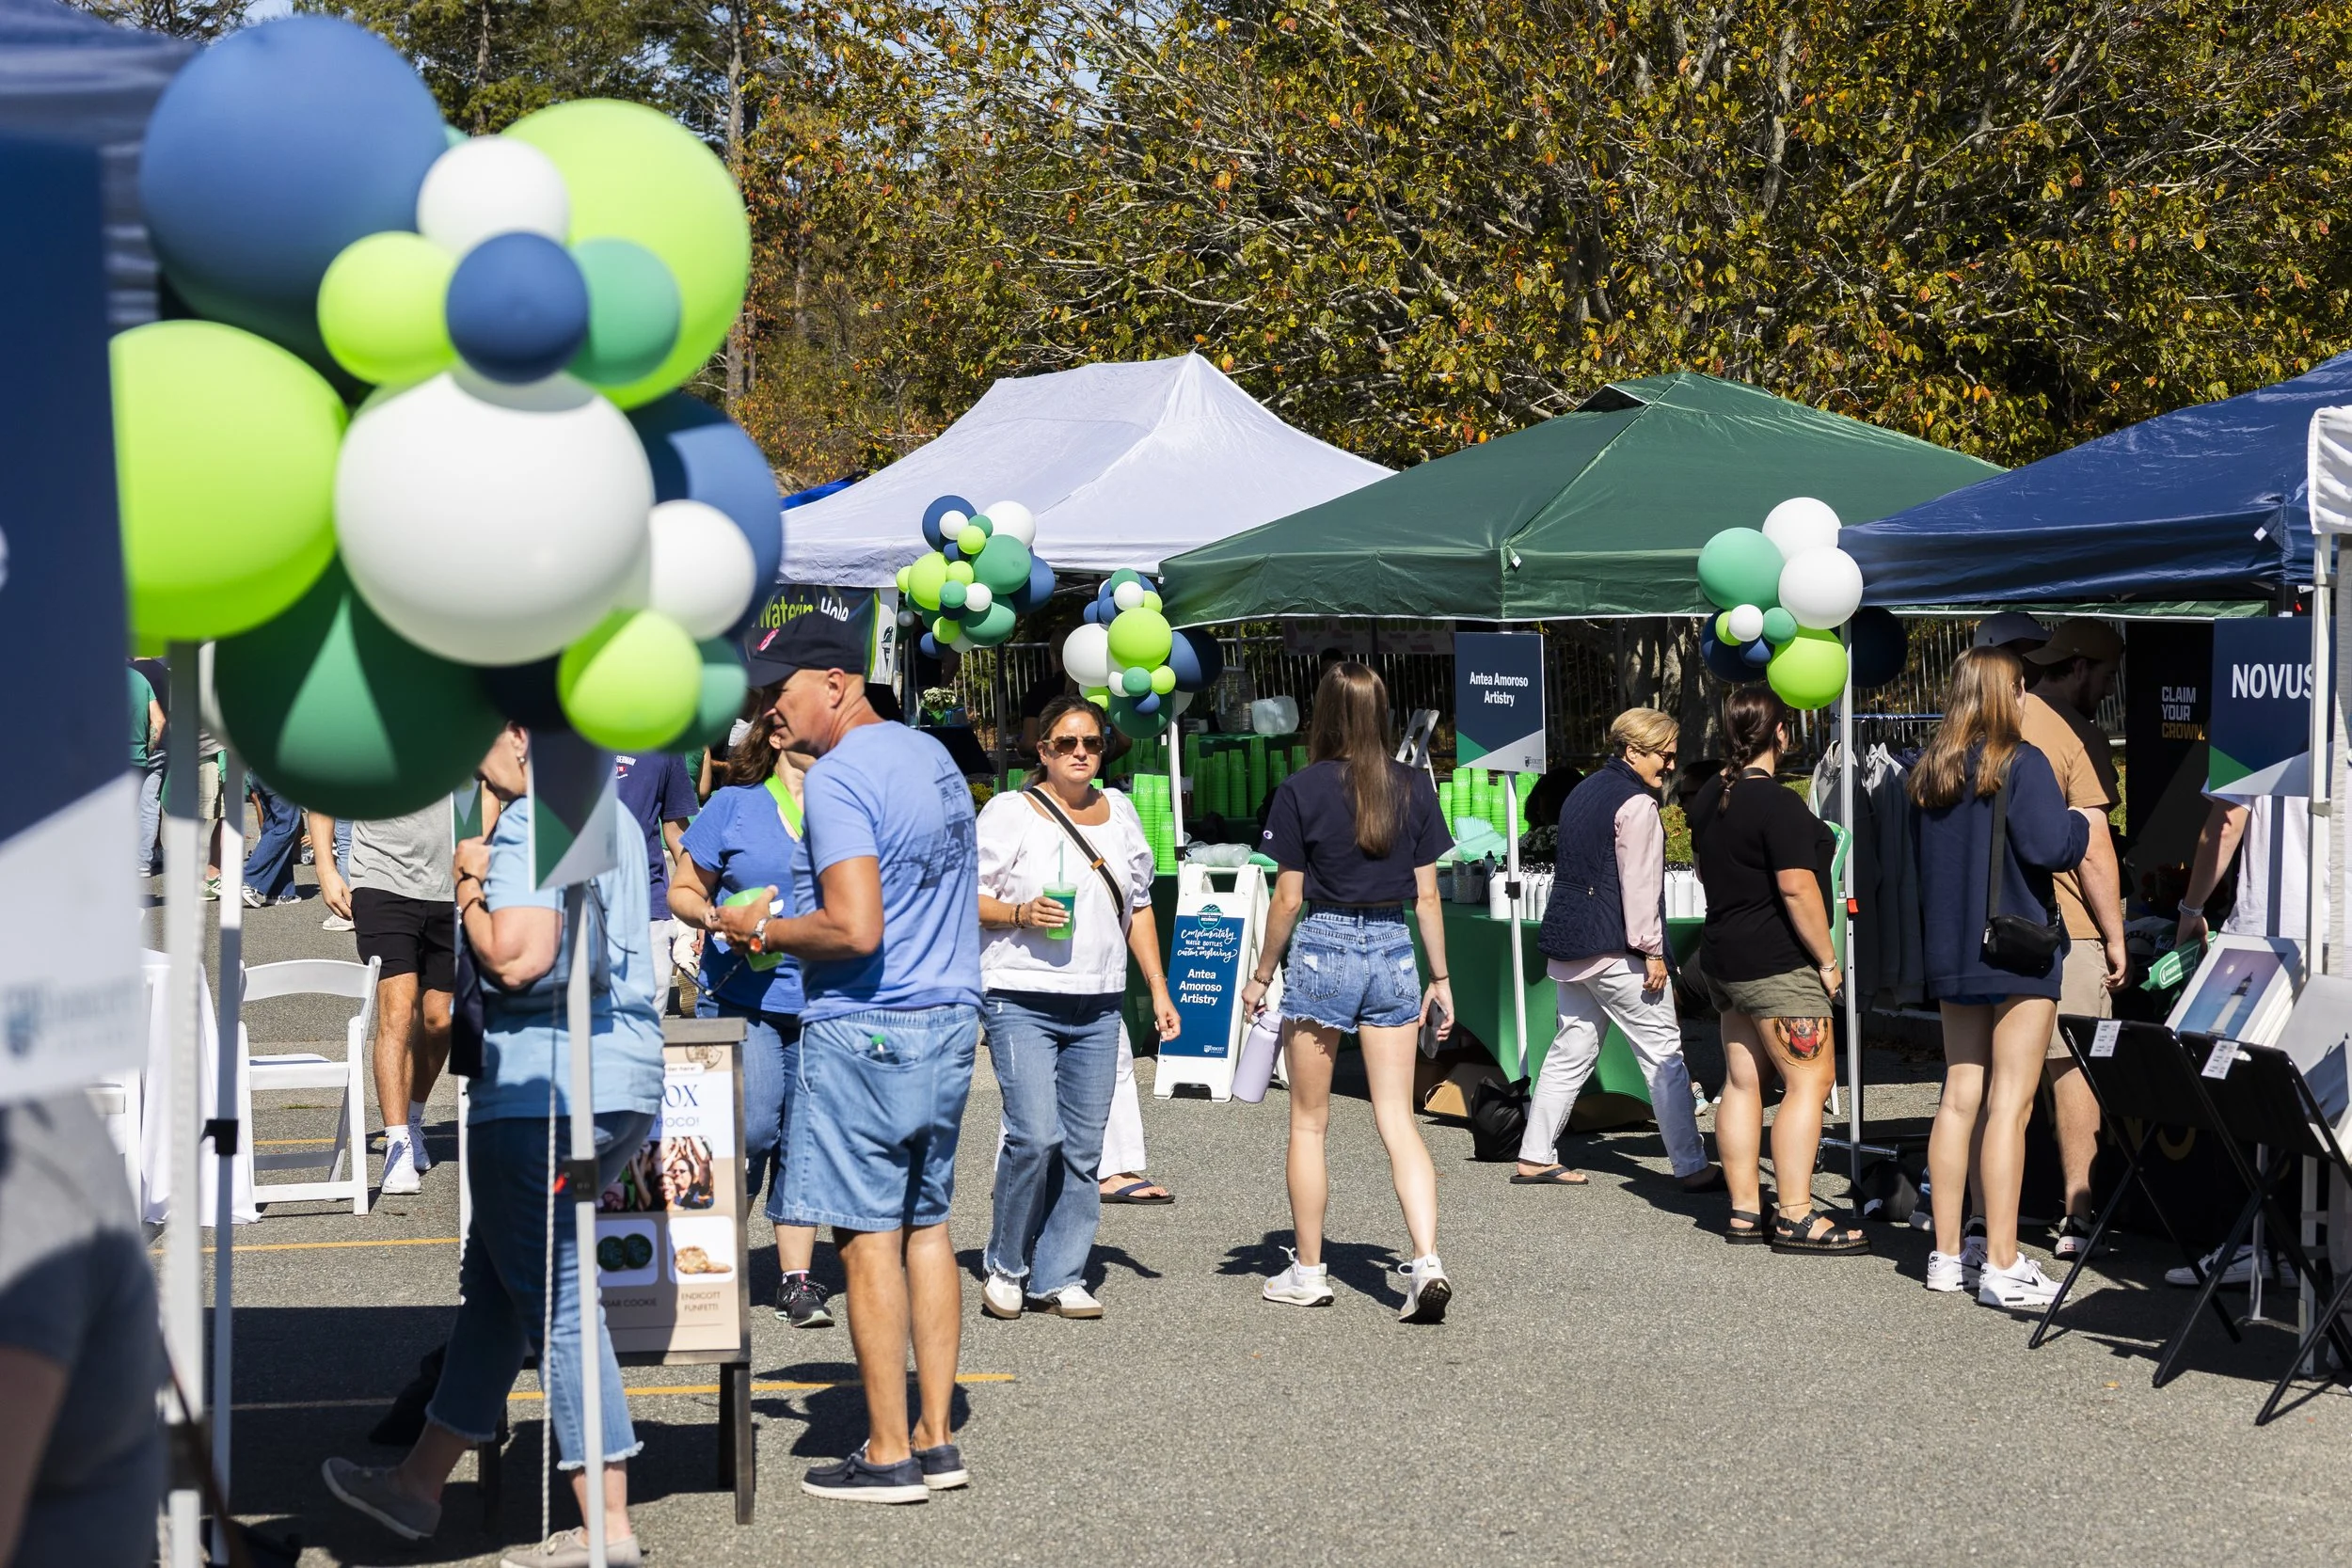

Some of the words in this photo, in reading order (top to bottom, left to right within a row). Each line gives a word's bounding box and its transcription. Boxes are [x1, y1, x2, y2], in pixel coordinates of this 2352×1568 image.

[760, 594, 814, 628] Waterin
[1470, 672, 1493, 685] Antea
[1494, 672, 1529, 688] Amoroso
[2232, 663, 2312, 699] NOVUS
[1484, 689, 1516, 707] Artistry
[2162, 687, 2196, 704] CLAIM
[2161, 705, 2190, 721] YOUR
[2162, 722, 2205, 741] CROWN.
[1187, 968, 1216, 979] Antea
[1179, 980, 1223, 991] Amoroso
[1180, 993, 1218, 1006] Artistry
[664, 1085, 698, 1107] OX
[680, 1291, 721, 1301] ENDICOTT
[684, 1303, 719, 1312] FUNFETTI
